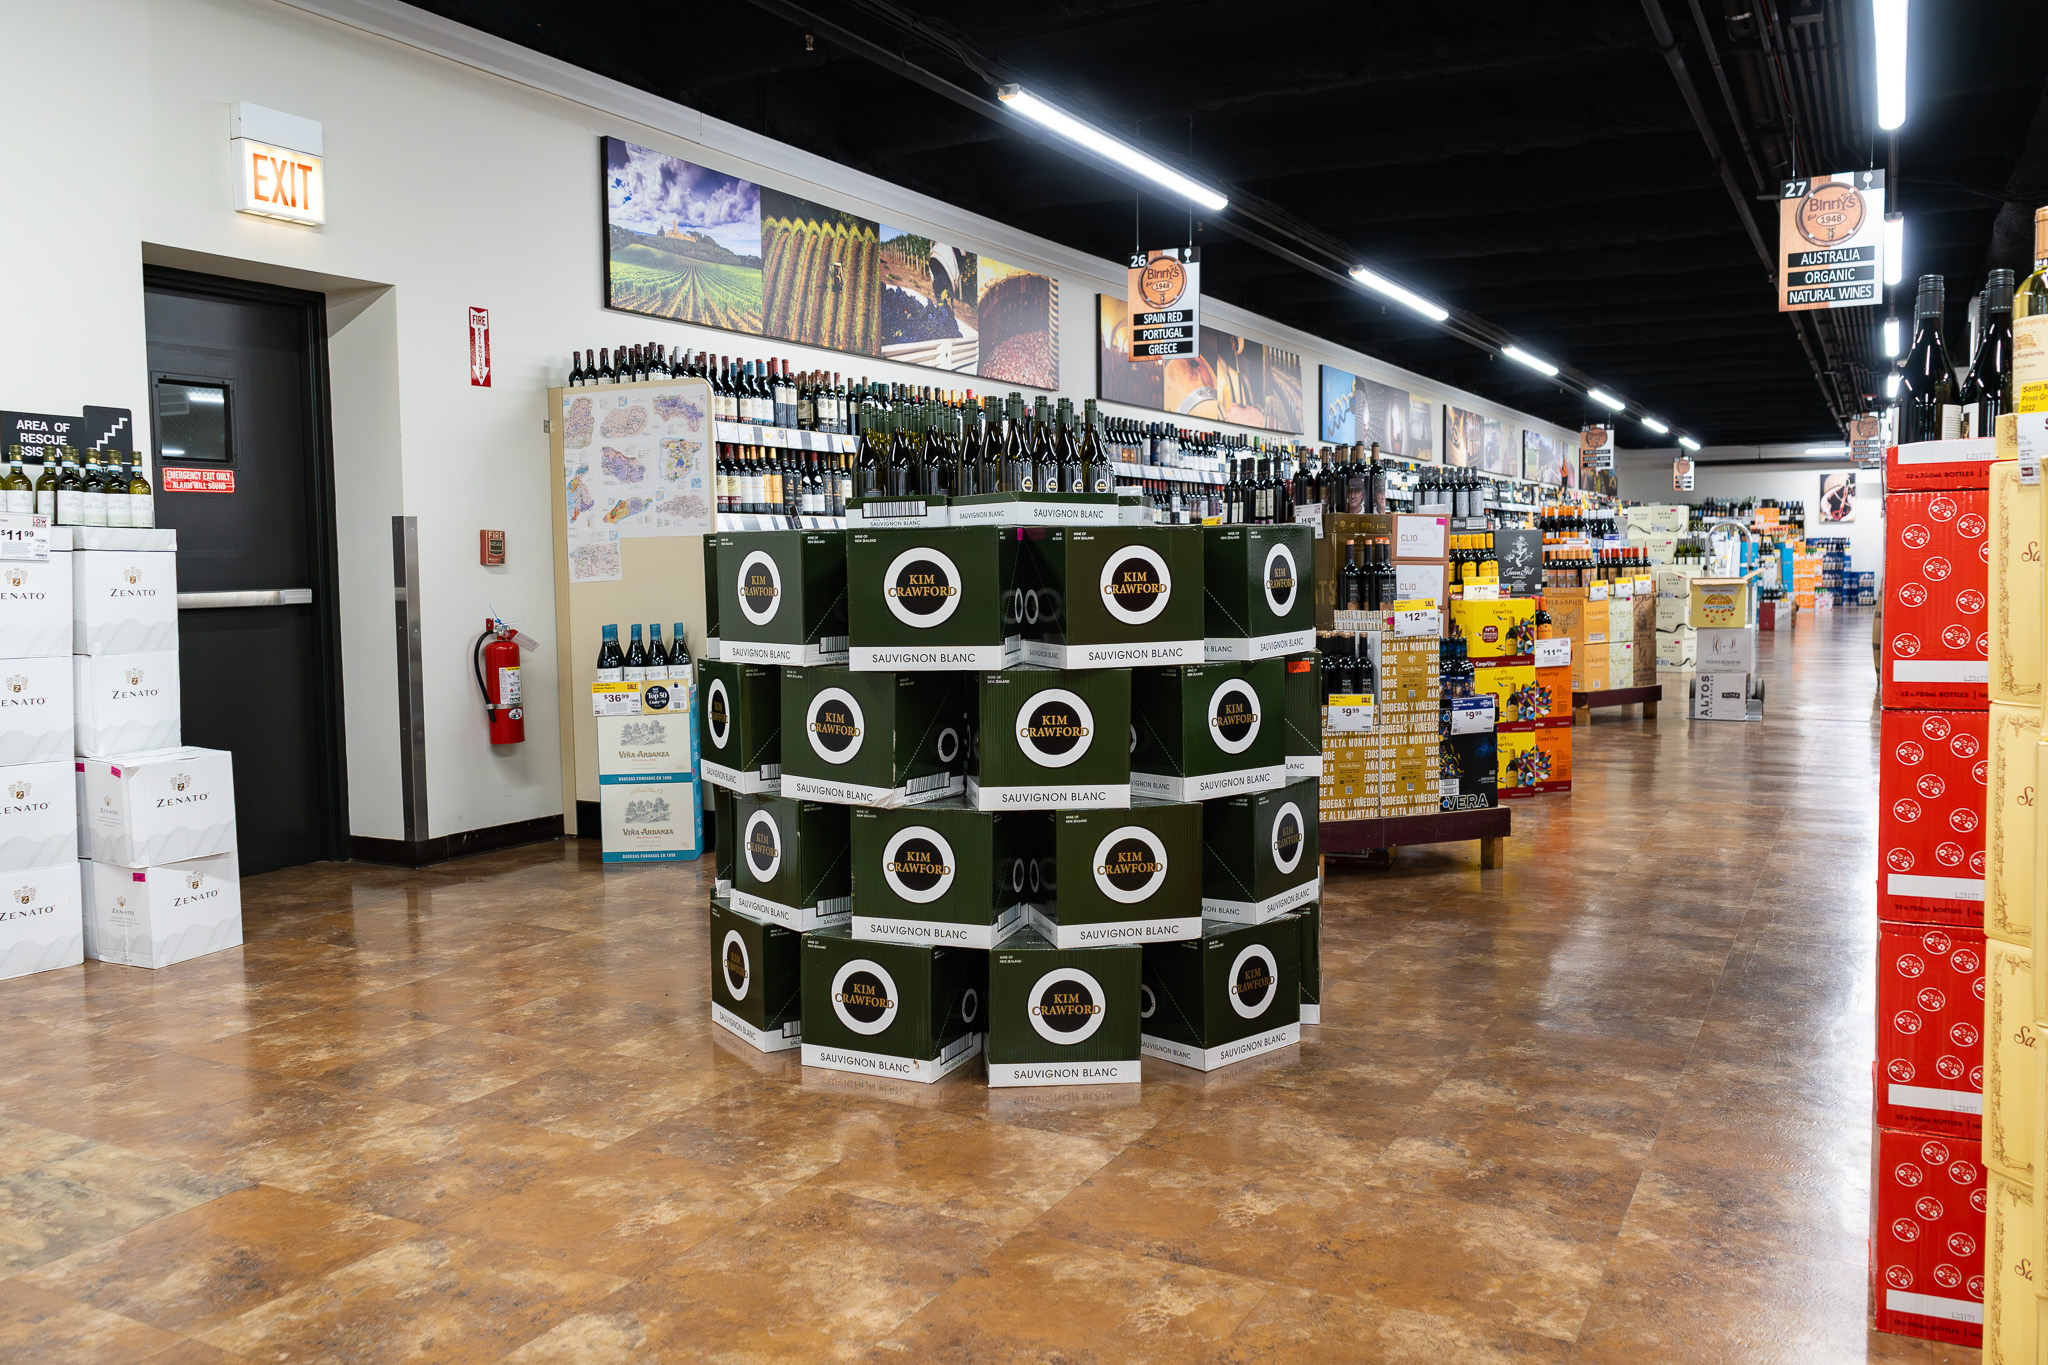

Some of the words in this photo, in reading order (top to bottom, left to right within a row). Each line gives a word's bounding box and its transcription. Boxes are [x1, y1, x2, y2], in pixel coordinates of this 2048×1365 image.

[252, 152, 314, 211] EXIT
[1784, 181, 1807, 198] 27
[1820, 214, 1842, 224] 1948
[1130, 255, 1146, 268] 26
[1800, 249, 1861, 265] AUSTRALIA
[1805, 268, 1856, 284] ORGANIC
[1156, 282, 1170, 290] 1948
[1789, 290, 1836, 304] NATURAL
[1838, 286, 1872, 299] WINES
[473, 315, 486, 326] FIRE
[1144, 314, 1166, 324] SPAIN
[1167, 312, 1183, 322] RED
[1143, 328, 1184, 340] PORTUGAL
[1149, 343, 1178, 355] GREECE
[2023, 384, 2042, 393] Santa
[16, 420, 48, 432] AREA
[54, 422, 70, 433] OF
[20, 433, 67, 446] RESCUE
[167, 471, 201, 480] EMERGENCY
[203, 472, 215, 480] EXIT
[216, 472, 231, 481] ONLY
[1944, 470, 1974, 478] BOTTLES
[960, 512, 988, 520] SAUVIGNON
[989, 510, 1005, 518] BLANC
[1034, 508, 1075, 519] SAUVIGNON
[1077, 508, 1104, 518] BLANC
[489, 532, 504, 540] FIRE
[1401, 534, 1418, 542] CLIO
[1124, 572, 1147, 582] KIM
[1274, 568, 1286, 578] KIM
[751, 576, 766, 585] KIM
[909, 574, 935, 585] KIM
[1266, 579, 1295, 590] CRAWFORD
[110, 589, 156, 597] ZENATO
[740, 586, 779, 597] CRAWFORD
[888, 586, 957, 598] CRAWFORD
[1104, 583, 1167, 595] CRAWFORD
[1260, 640, 1287, 652] SAUVIGNON
[1288, 638, 1304, 649] BLANC
[1382, 644, 1390, 652] DE
[1392, 643, 1409, 652] ALTA
[1410, 641, 1440, 652] MONTAÑA
[732, 648, 768, 658] SAUVIGNON
[770, 649, 791, 660] BLANC
[872, 654, 938, 663] SAUVIGNON
[940, 653, 976, 663] BLANC
[1088, 649, 1149, 661] SAUVIGNON
[1152, 648, 1183, 659] BLANC
[112, 689, 158, 700] ZENATO
[1701, 675, 1710, 717] ALTOS
[0, 698, 45, 707] ENATO
[1225, 703, 1244, 714] KIM
[1382, 704, 1409, 712] BODEGAS
[1415, 701, 1440, 710] VIÑEDOS
[826, 712, 845, 724] KIM
[1042, 715, 1068, 726] KIM
[1211, 714, 1258, 727] CRAWFORD
[810, 722, 861, 737] CRAWFORD
[1020, 726, 1089, 738] CRAWFORD
[637, 750, 670, 758] ARDANZA
[1200, 778, 1244, 791] SAUVIGNON
[1245, 773, 1270, 785] BLANC
[796, 782, 844, 798] SAUVIGNON
[846, 790, 873, 802] BLANC
[1002, 792, 1068, 803] SAUVIGNON
[1071, 791, 1106, 801] BLANC
[156, 794, 208, 808] ZENATO
[623, 828, 641, 836] VIÑA
[1282, 825, 1294, 838] KIM
[756, 833, 769, 844] KIM
[1273, 833, 1302, 851] CRAWFORD
[747, 842, 779, 858] CRAWFORD
[907, 852, 931, 862] KIM
[1118, 852, 1143, 863] KIM
[887, 862, 951, 876] CRAWFORD
[1097, 862, 1163, 876] CRAWFORD
[174, 890, 219, 907] ZENATO
[1267, 895, 1294, 914] SAUVIGNON
[1294, 888, 1310, 903] BLANC
[738, 898, 770, 916] SAUVIGNON
[770, 908, 790, 920] BLANC
[870, 924, 931, 937] SAUVIGNON
[934, 928, 968, 940] BLANC
[1080, 928, 1143, 940] SAUVIGNON
[1146, 925, 1179, 936] BLANC
[731, 952, 740, 964] KIM
[1245, 967, 1261, 981] KIM
[853, 984, 875, 995] KIM
[1231, 975, 1275, 996] CRAWFORD
[834, 993, 894, 1010] CRAWFORD
[1054, 993, 1080, 1004] KIM
[1032, 1004, 1101, 1016] CRAWFORD
[719, 1012, 742, 1034] SAUVIGNON
[743, 1026, 756, 1041] BLANC
[1221, 1041, 1262, 1060] SAUVIGNON
[1264, 1032, 1287, 1048] BLANC
[820, 1052, 876, 1069] SAUVIGNON
[878, 1062, 910, 1074] BLANC
[1014, 1068, 1080, 1079] SAUVIGNON
[1082, 1067, 1118, 1078] BLANC
